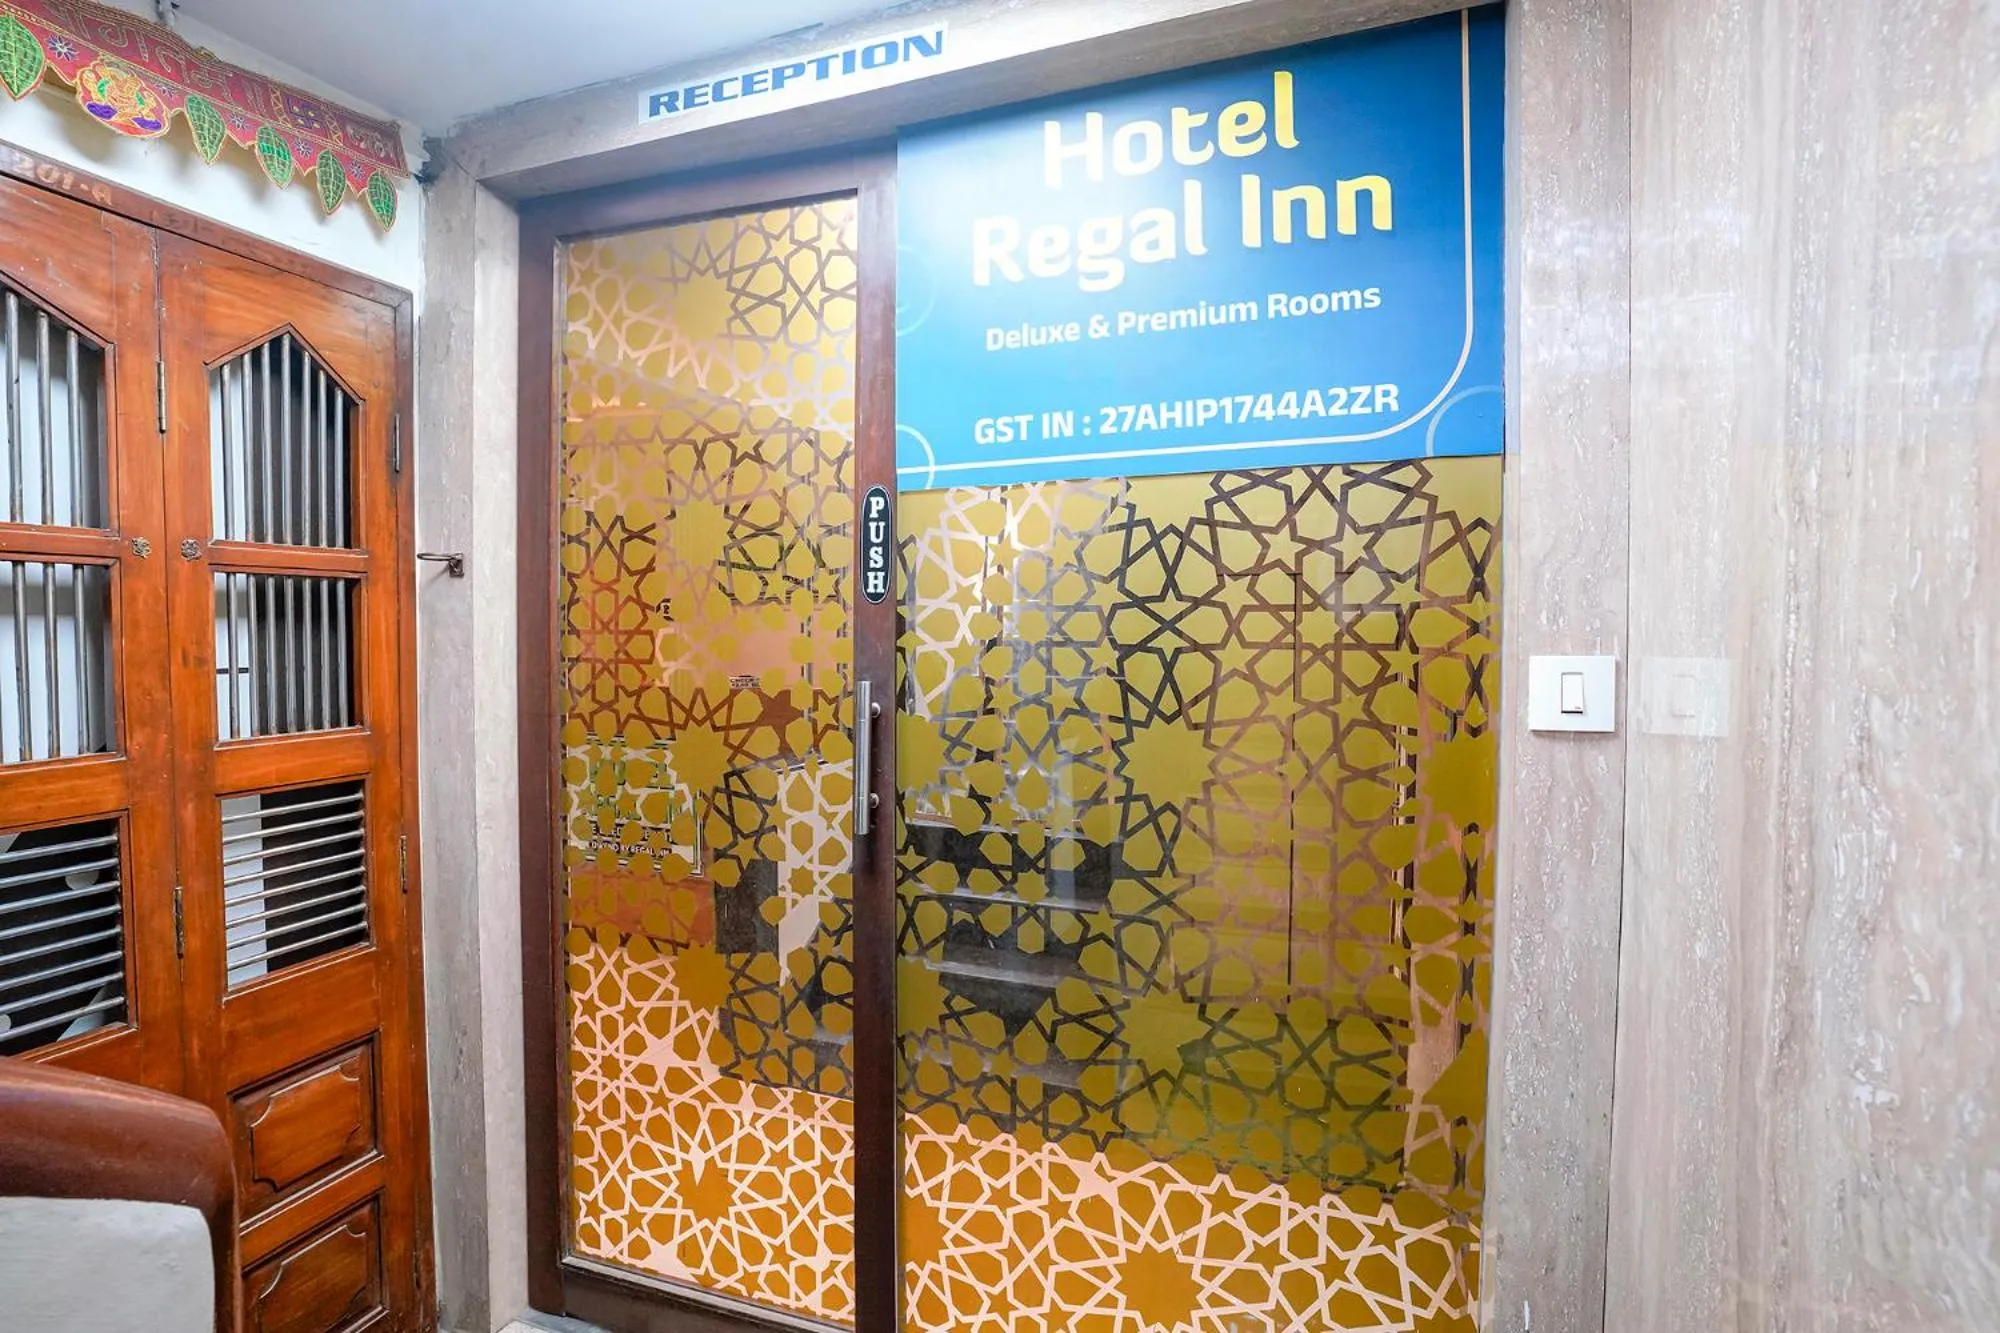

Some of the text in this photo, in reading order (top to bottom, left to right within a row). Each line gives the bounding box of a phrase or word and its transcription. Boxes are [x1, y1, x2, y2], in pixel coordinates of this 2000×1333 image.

[649, 30, 944, 118] RECEPTION
[1044, 71, 1299, 191] Hotel
[972, 174, 1393, 292] Regal Inn
[986, 287, 1382, 352] Deluxe & Premium Rooms
[974, 414, 1034, 446] GST
[1041, 411, 1074, 440] IN
[1100, 384, 1400, 434] 27AHIP1744A2ZR
[867, 496, 886, 588] PUSH
